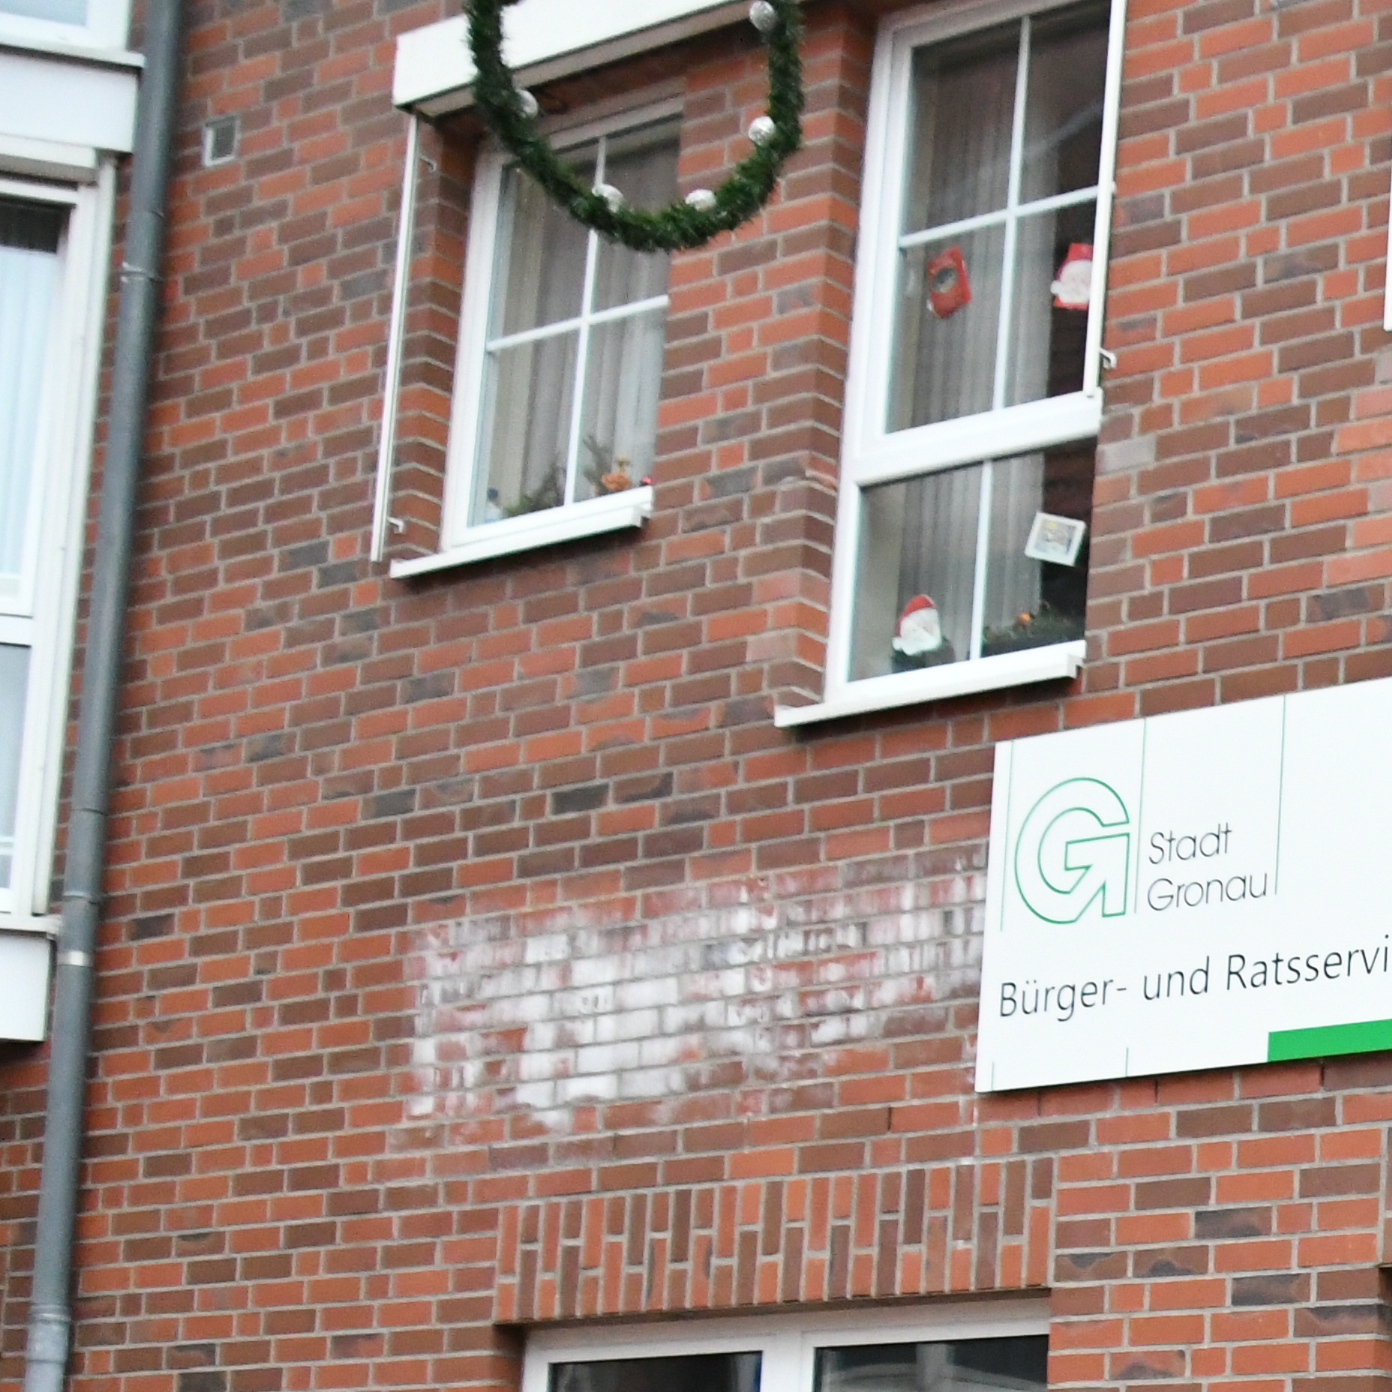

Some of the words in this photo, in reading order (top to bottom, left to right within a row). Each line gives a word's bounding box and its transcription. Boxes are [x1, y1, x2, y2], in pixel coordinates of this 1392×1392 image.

[1148, 822, 1233, 865] Stadt
[1147, 872, 1268, 912] Gronau
[999, 976, 1128, 1022] Bürger-
[1142, 955, 1210, 1001] und
